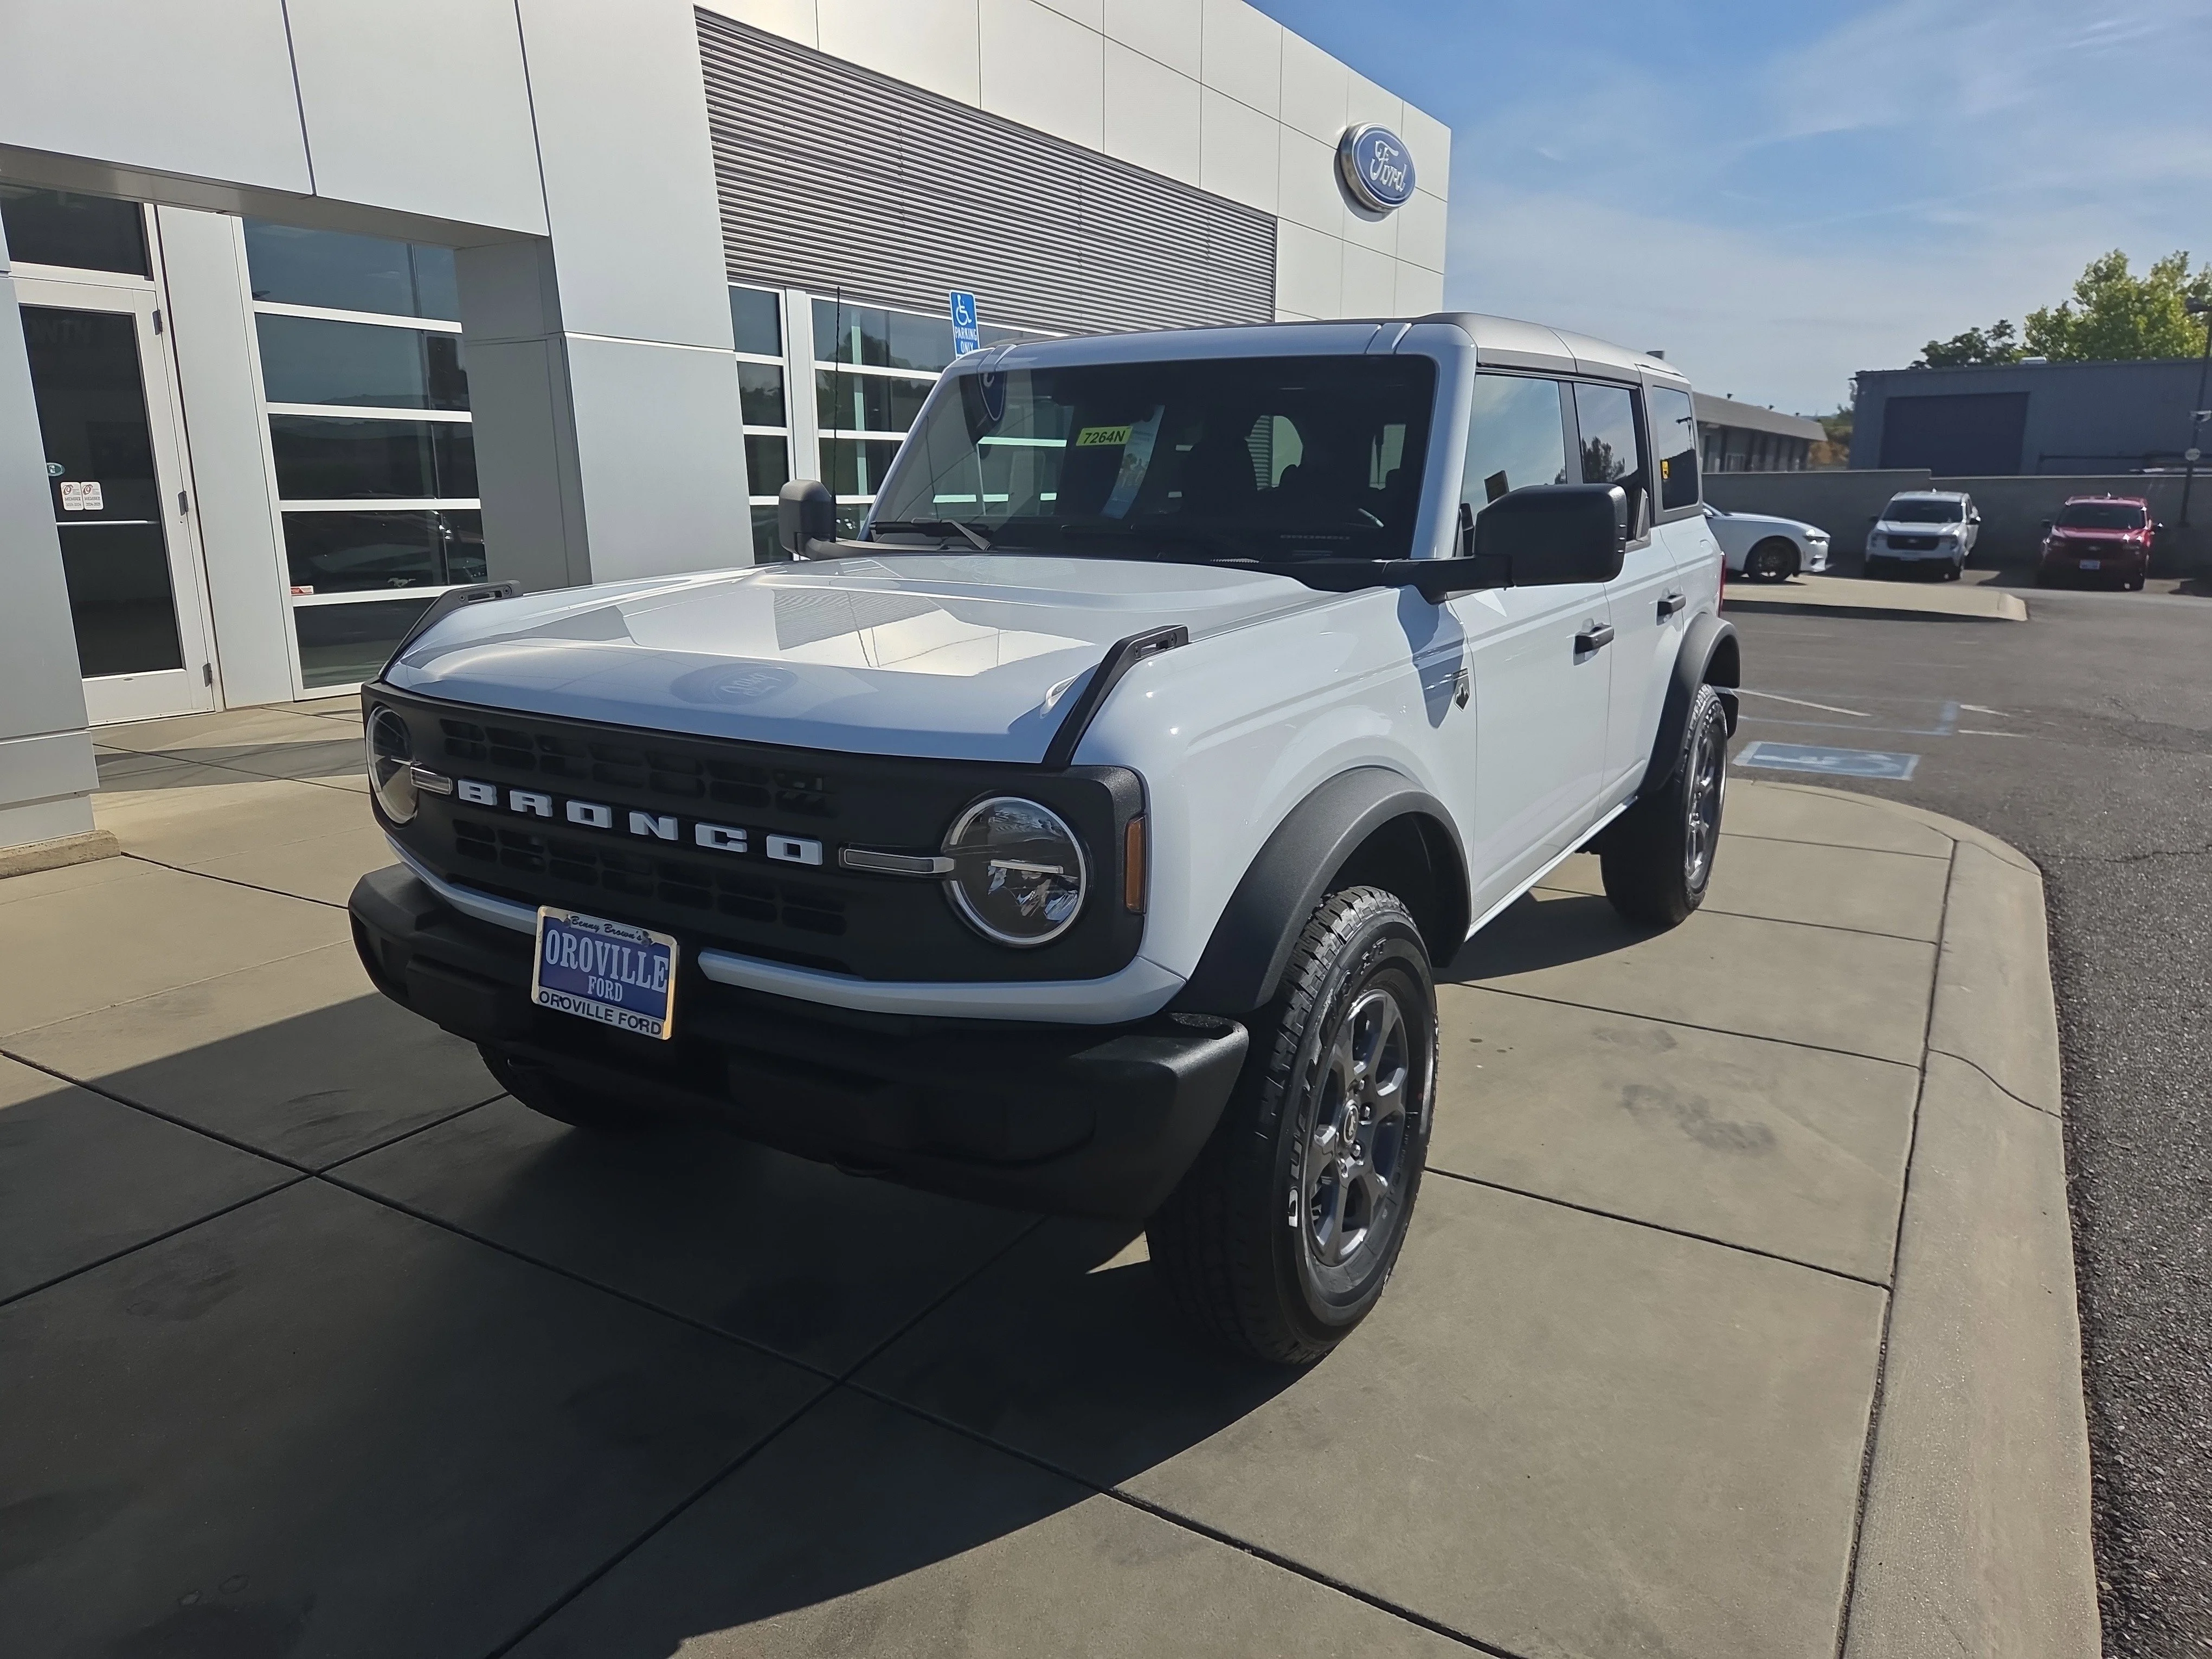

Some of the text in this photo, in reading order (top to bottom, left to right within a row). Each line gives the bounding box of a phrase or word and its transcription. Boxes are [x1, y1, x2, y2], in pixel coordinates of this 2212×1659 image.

[1369, 140, 1407, 192] Ford
[954, 326, 977, 341] PARKING
[960, 340, 974, 353] ONLY
[1083, 430, 1126, 443] 7264N
[458, 779, 823, 866] BRONCO
[570, 915, 642, 941] Benny Brown's
[545, 929, 669, 993] OROVILLE
[587, 975, 623, 1002] FORD
[539, 991, 662, 1036] OROVILLE FORD
